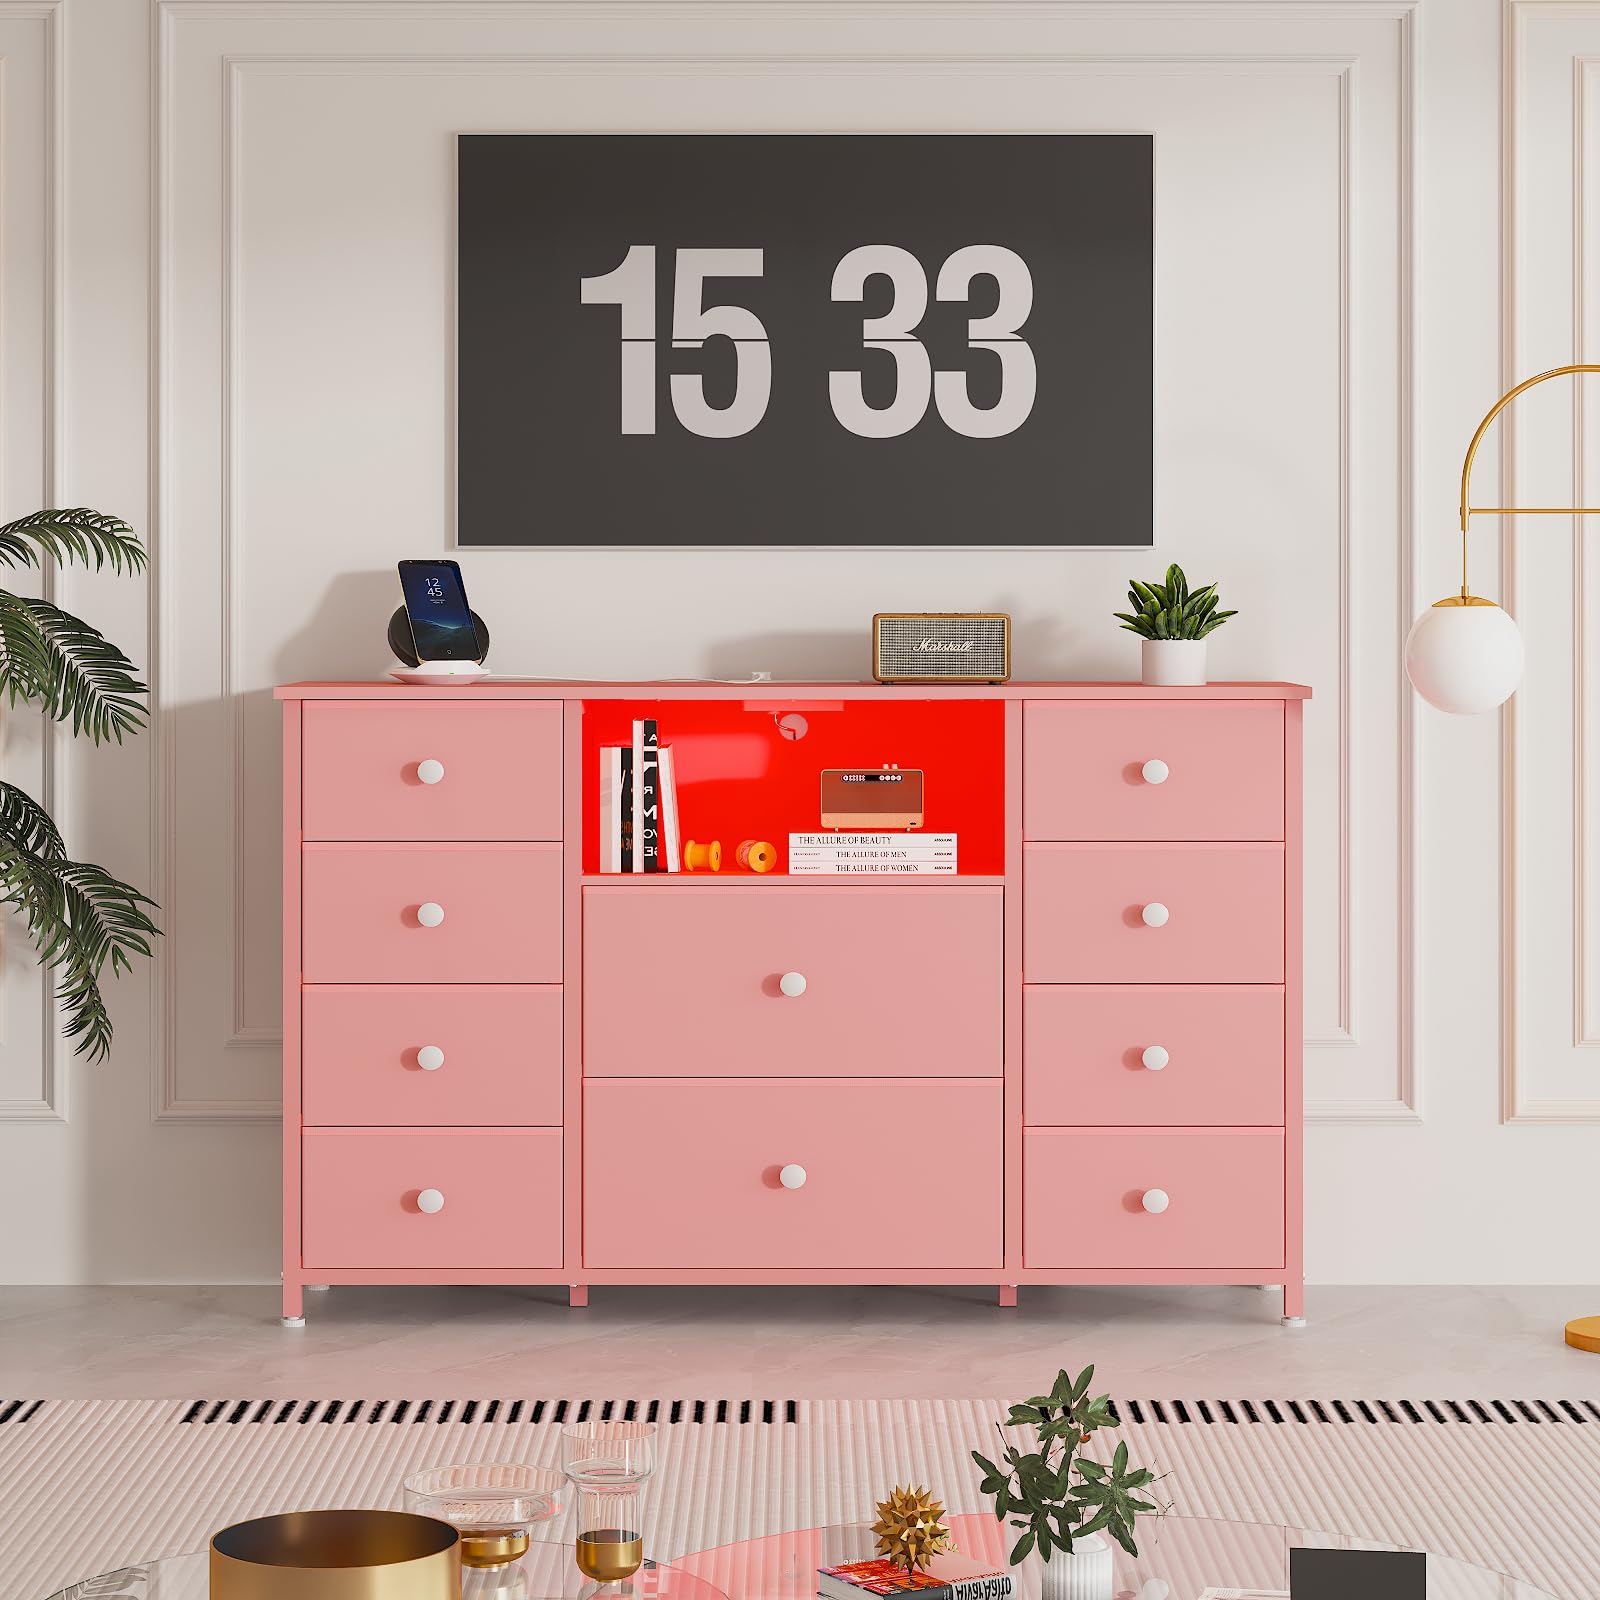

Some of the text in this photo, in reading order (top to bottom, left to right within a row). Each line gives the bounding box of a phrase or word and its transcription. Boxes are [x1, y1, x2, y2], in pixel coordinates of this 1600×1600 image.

[580, 244, 1038, 439] 15 33
[425, 577, 442, 587] 12
[427, 587, 443, 597] 45
[912, 637, 974, 653] Marshall
[799, 836, 892, 845] THE ALLURE OF BEAUTY
[836, 851, 907, 859] THE ALLURE OF MEN
[836, 864, 919, 872] THE ALLURE OF WOMEN
